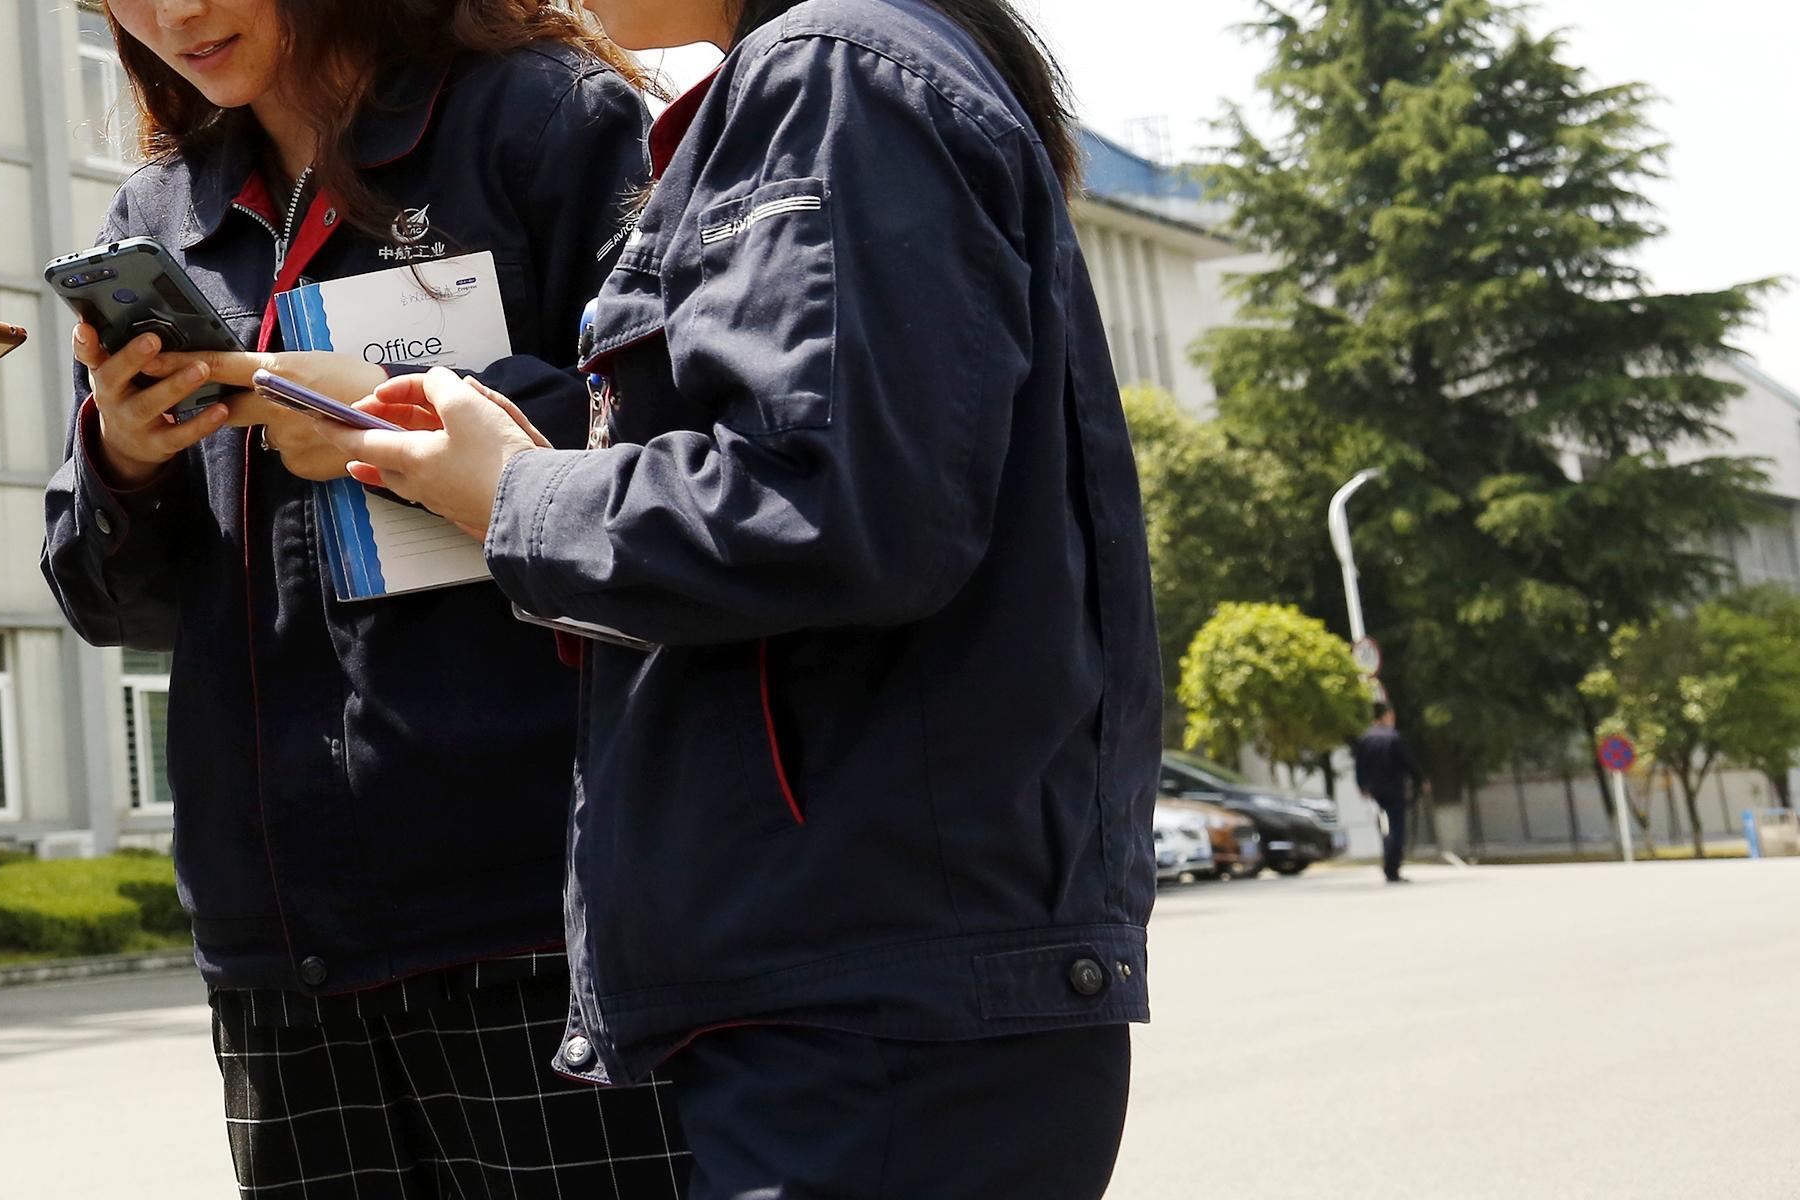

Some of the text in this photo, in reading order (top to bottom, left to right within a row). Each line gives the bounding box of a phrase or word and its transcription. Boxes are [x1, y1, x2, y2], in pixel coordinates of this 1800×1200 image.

[378, 241, 446, 260] 中航工业
[363, 337, 442, 364] Office
